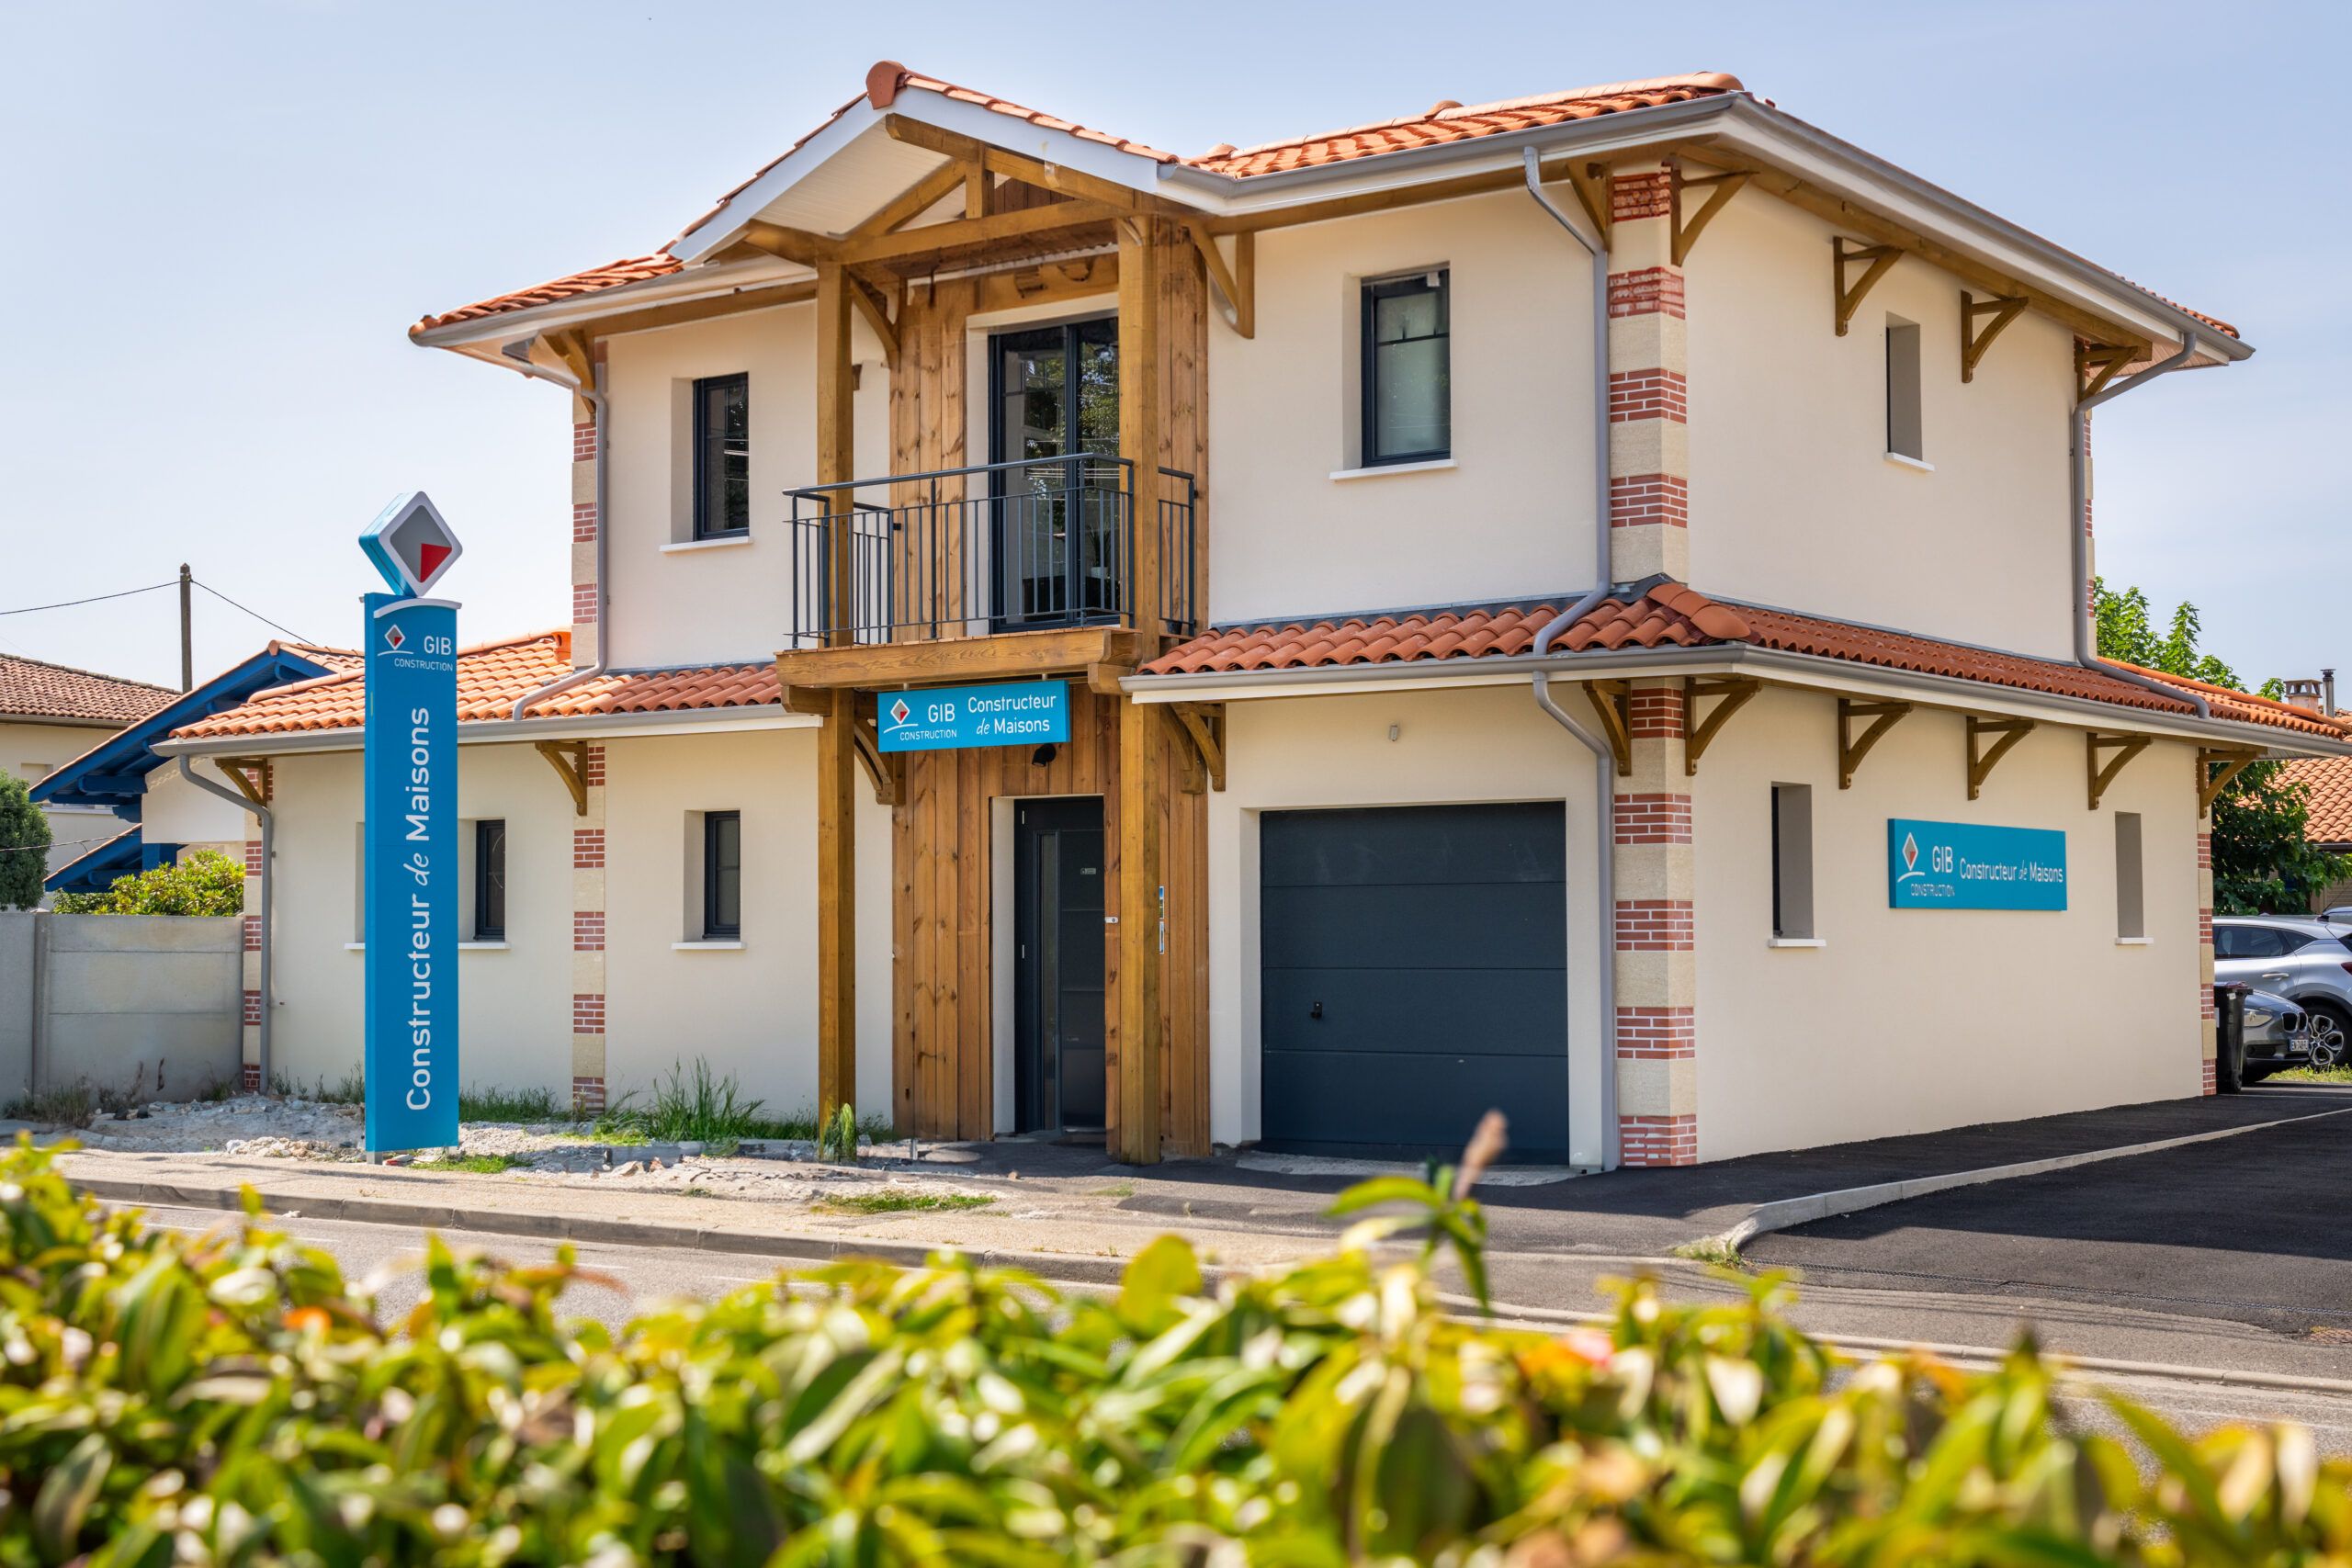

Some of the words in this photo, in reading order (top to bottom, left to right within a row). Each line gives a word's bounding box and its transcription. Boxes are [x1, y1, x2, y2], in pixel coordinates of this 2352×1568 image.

[424, 636, 452, 655] GIB
[394, 658, 453, 671] CONSTRUCTION
[967, 694, 1057, 713] Constructeur
[928, 704, 956, 723] GIB
[899, 729, 957, 741] CONSTRUCTION
[976, 718, 989, 735] de
[994, 717, 1050, 733] Maisons
[405, 707, 429, 841] Maisons
[1932, 846, 1953, 873] GIB
[403, 853, 430, 886] de
[1960, 858, 2017, 880] Constructeur
[2018, 860, 2028, 880] de
[2030, 862, 2064, 882] Maisons
[1910, 884, 1955, 897] CONSTRUCTION
[406, 894, 430, 1111] Constructeur
